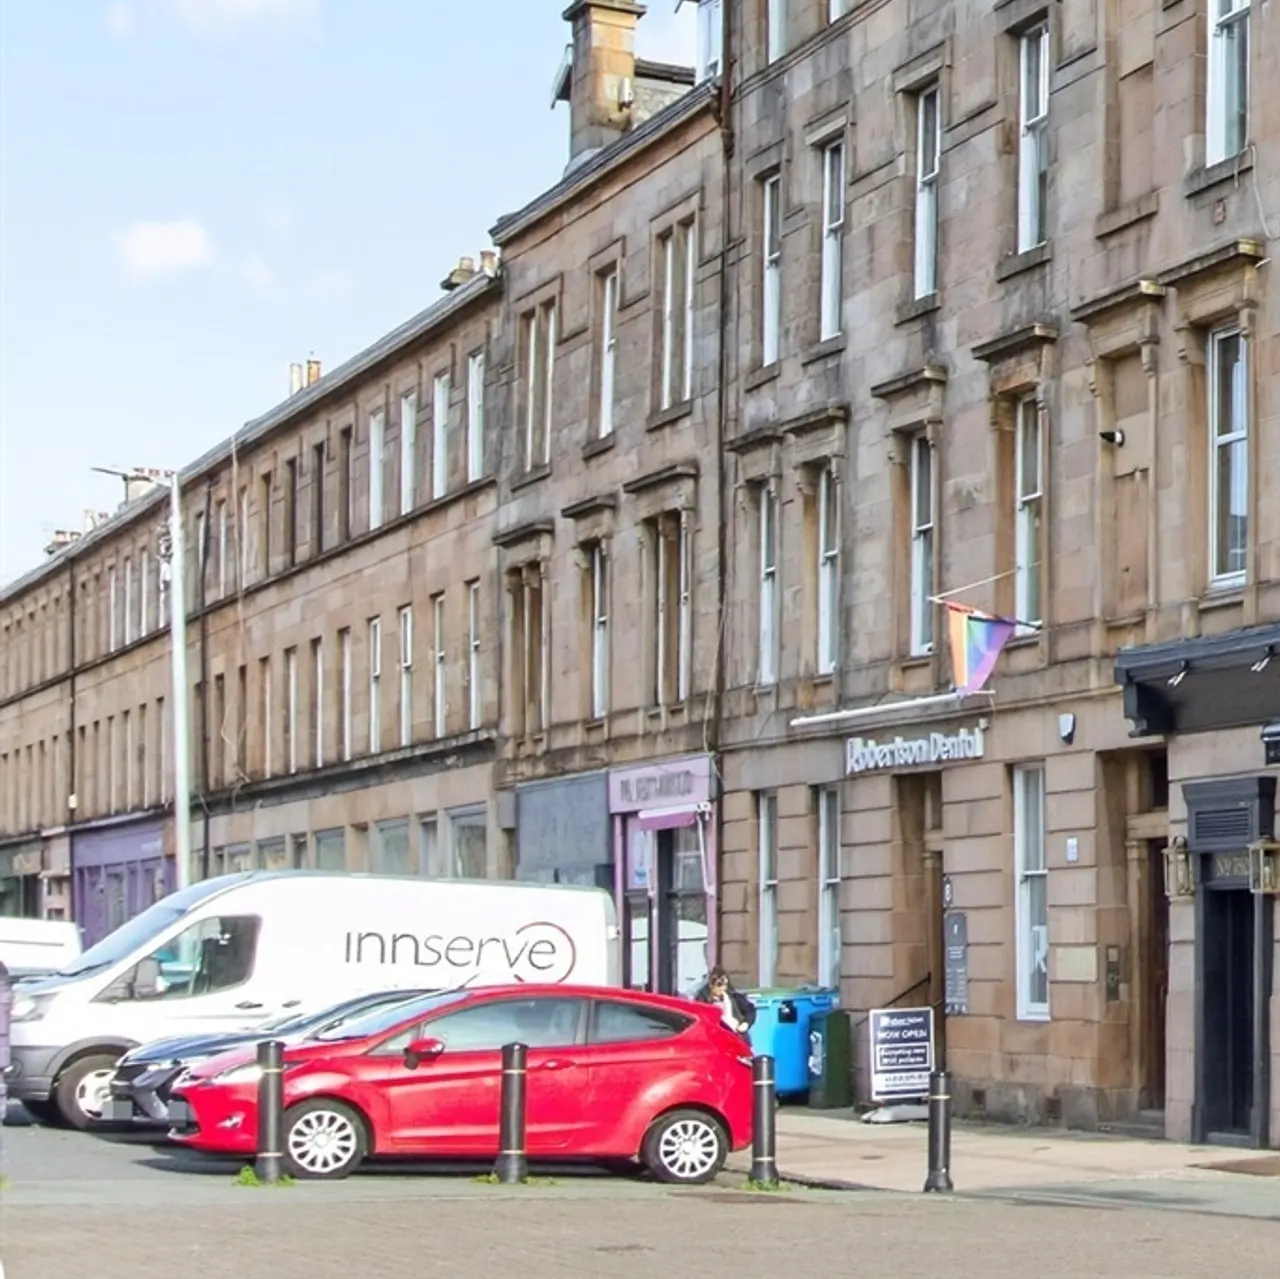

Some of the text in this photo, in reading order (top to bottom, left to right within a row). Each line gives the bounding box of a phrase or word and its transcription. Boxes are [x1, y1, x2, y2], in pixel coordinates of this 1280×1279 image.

[846, 727, 984, 775] Robertson Dental
[345, 931, 557, 971] innserve
